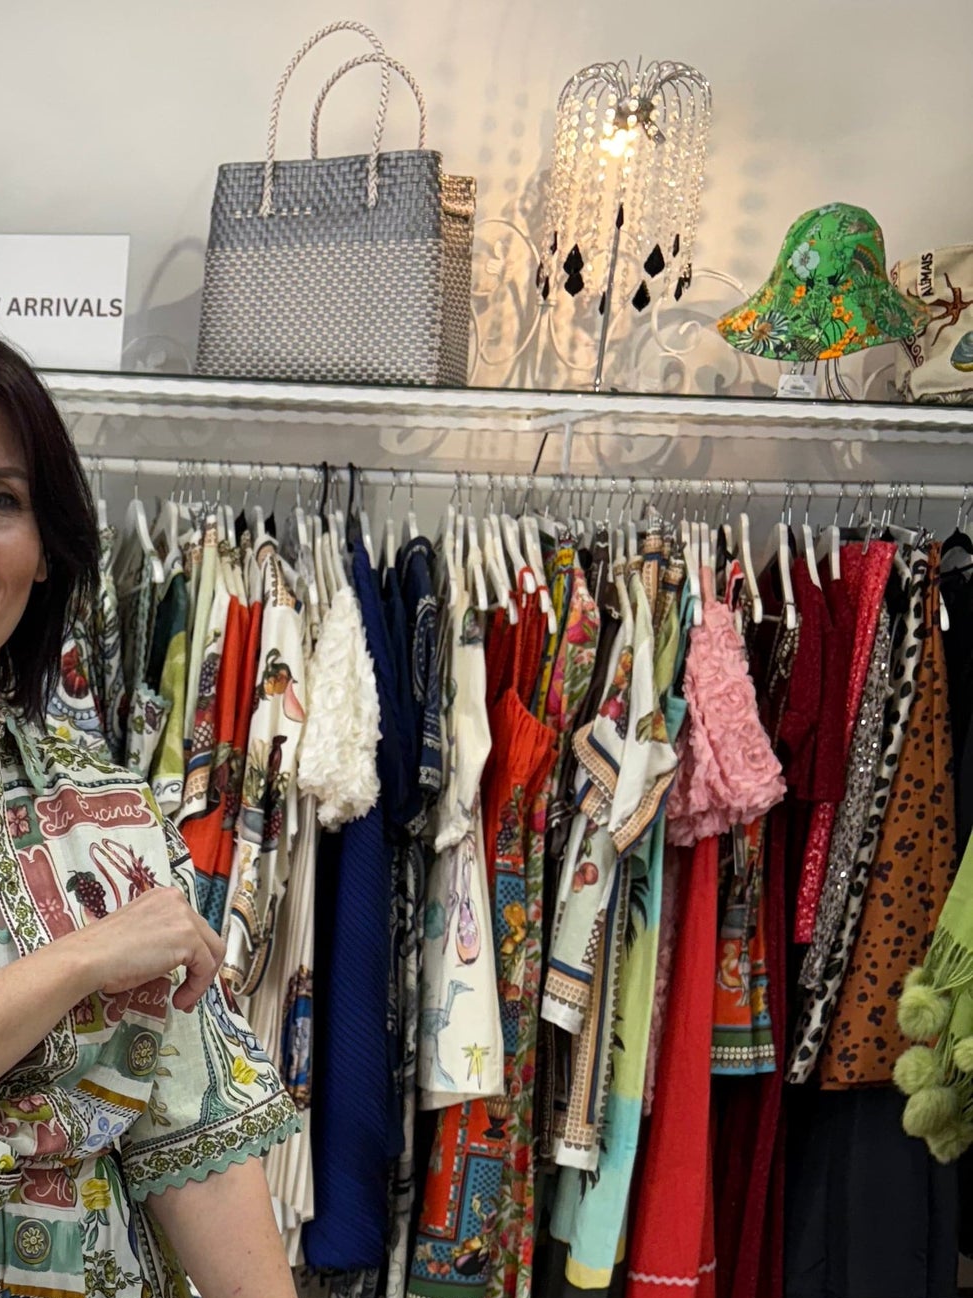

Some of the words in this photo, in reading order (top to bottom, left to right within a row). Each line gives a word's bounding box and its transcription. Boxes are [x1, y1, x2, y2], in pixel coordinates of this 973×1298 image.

[6, 297, 123, 317] ARRIVALS
[47, 799, 74, 832] La
[76, 794, 143, 822] Cucina
